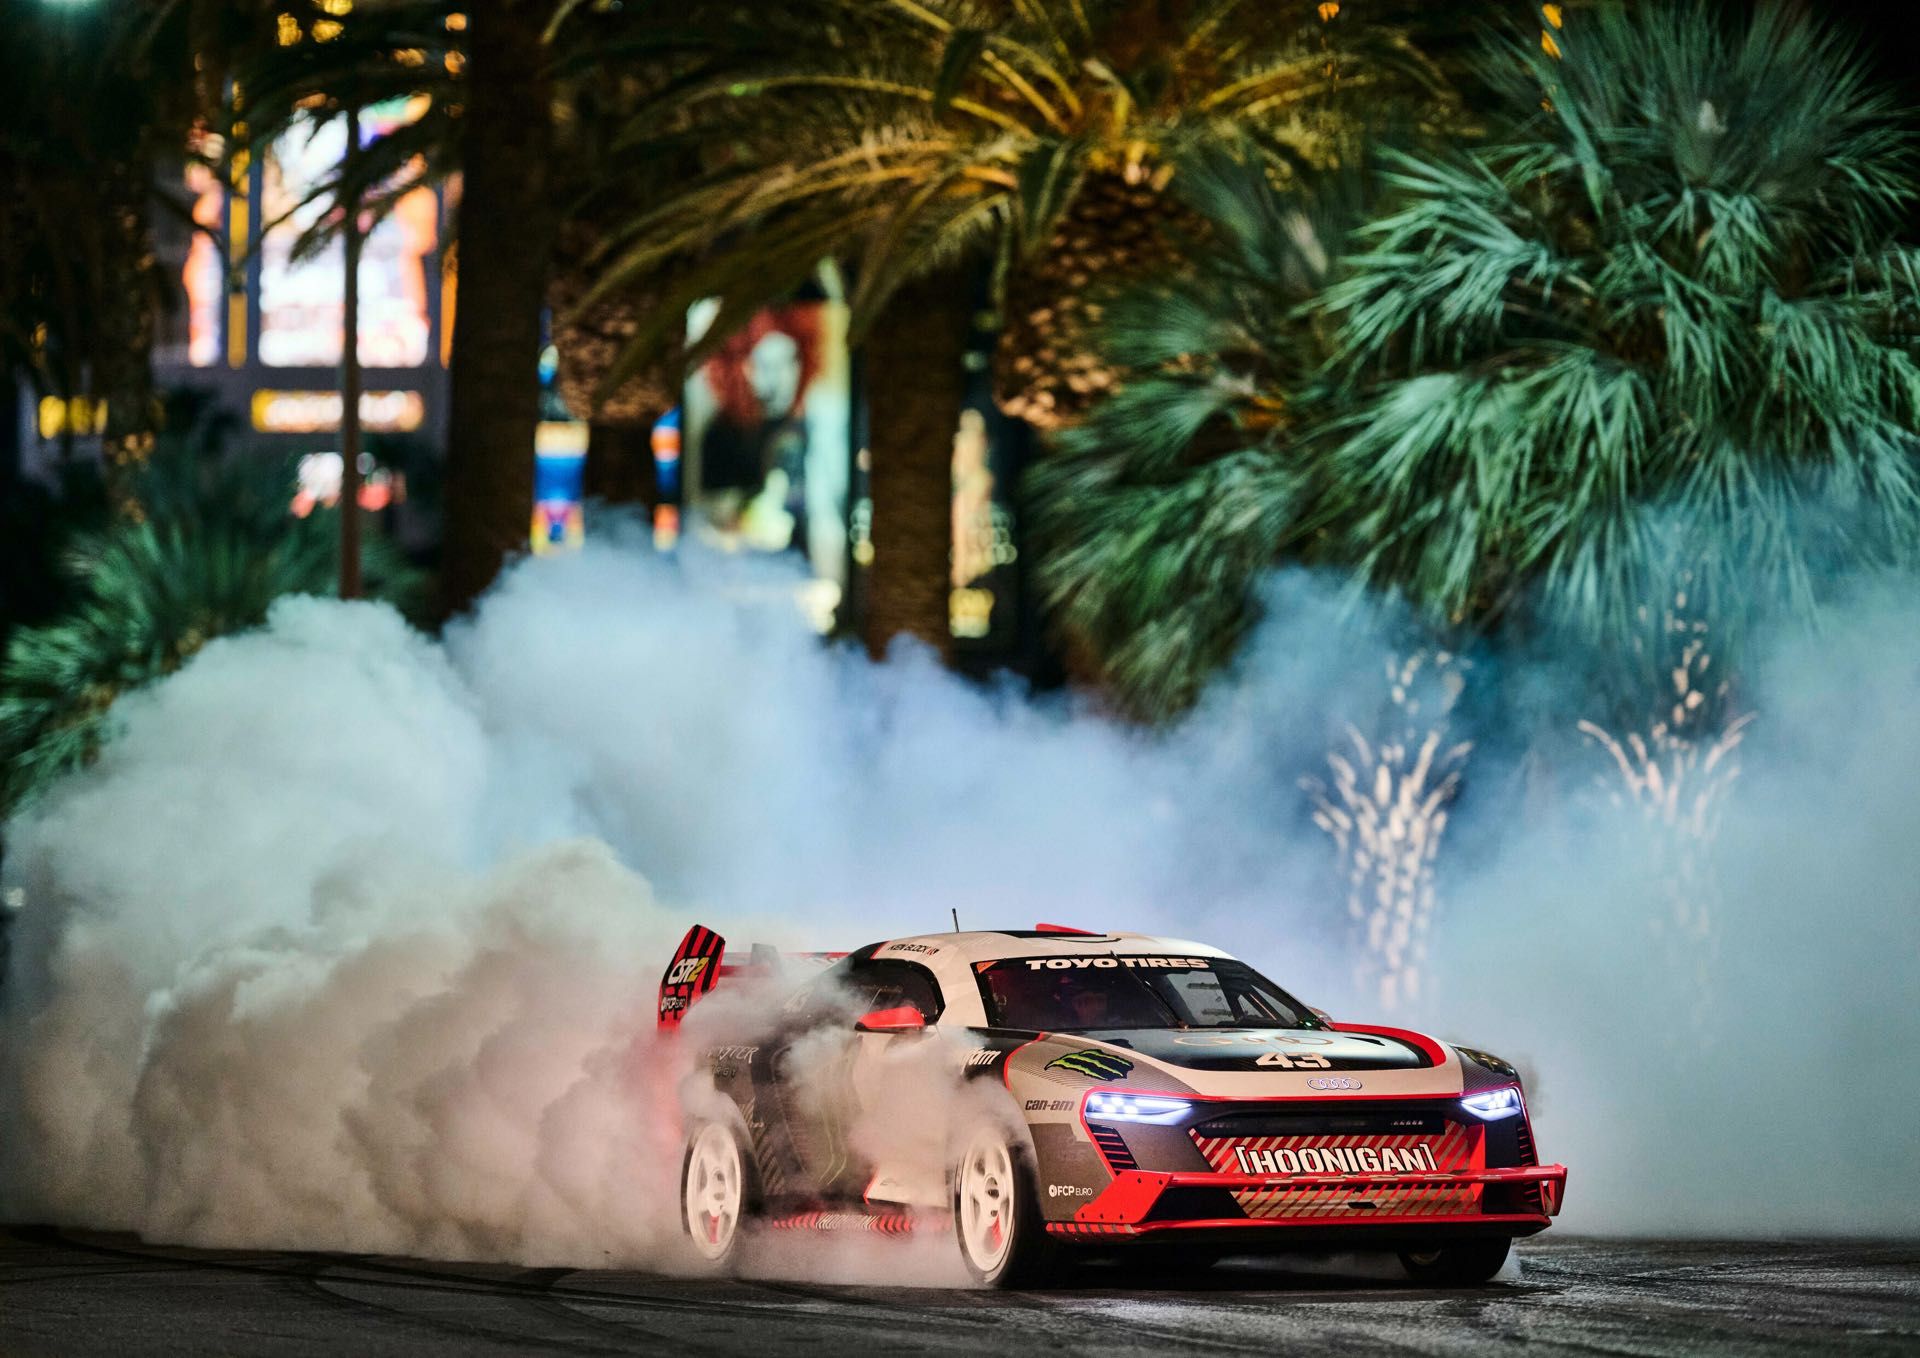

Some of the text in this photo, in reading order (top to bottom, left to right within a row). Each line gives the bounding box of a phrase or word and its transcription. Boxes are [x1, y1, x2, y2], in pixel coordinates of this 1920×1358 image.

[667, 956, 710, 985] CSR2
[1025, 957, 1210, 971] TOYO TIRES
[1255, 1052, 1332, 1069] 43
[1025, 1099, 1076, 1111] can-am
[1057, 1185, 1093, 1196] FCP EURO
